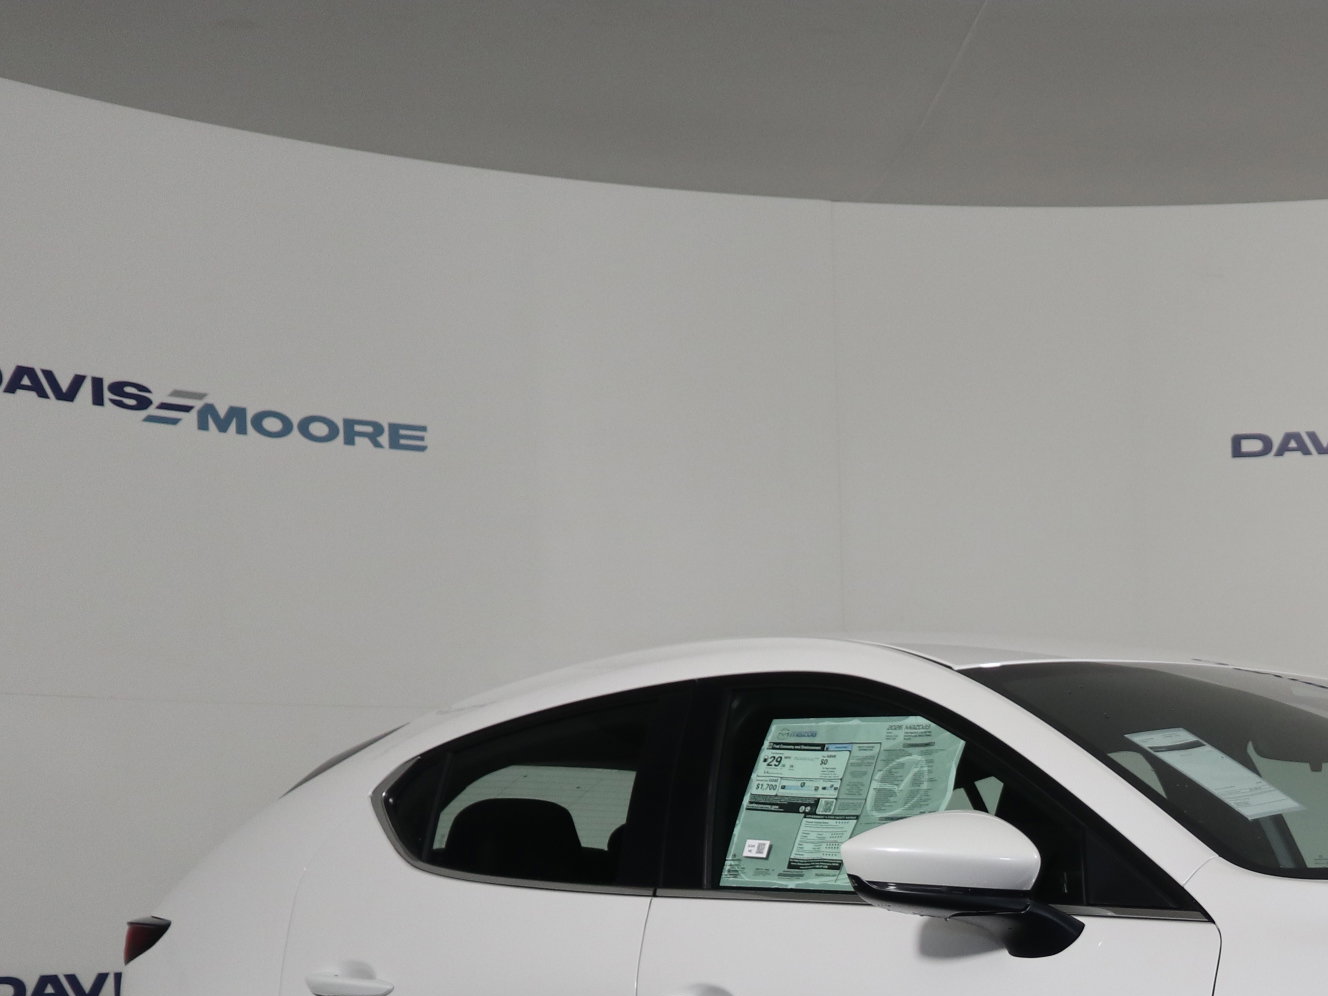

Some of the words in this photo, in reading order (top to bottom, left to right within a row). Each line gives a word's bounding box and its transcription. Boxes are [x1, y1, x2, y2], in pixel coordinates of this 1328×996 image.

[0, 364, 153, 411] AVIS
[196, 402, 428, 453] MOORE
[766, 755, 783, 767] 29
